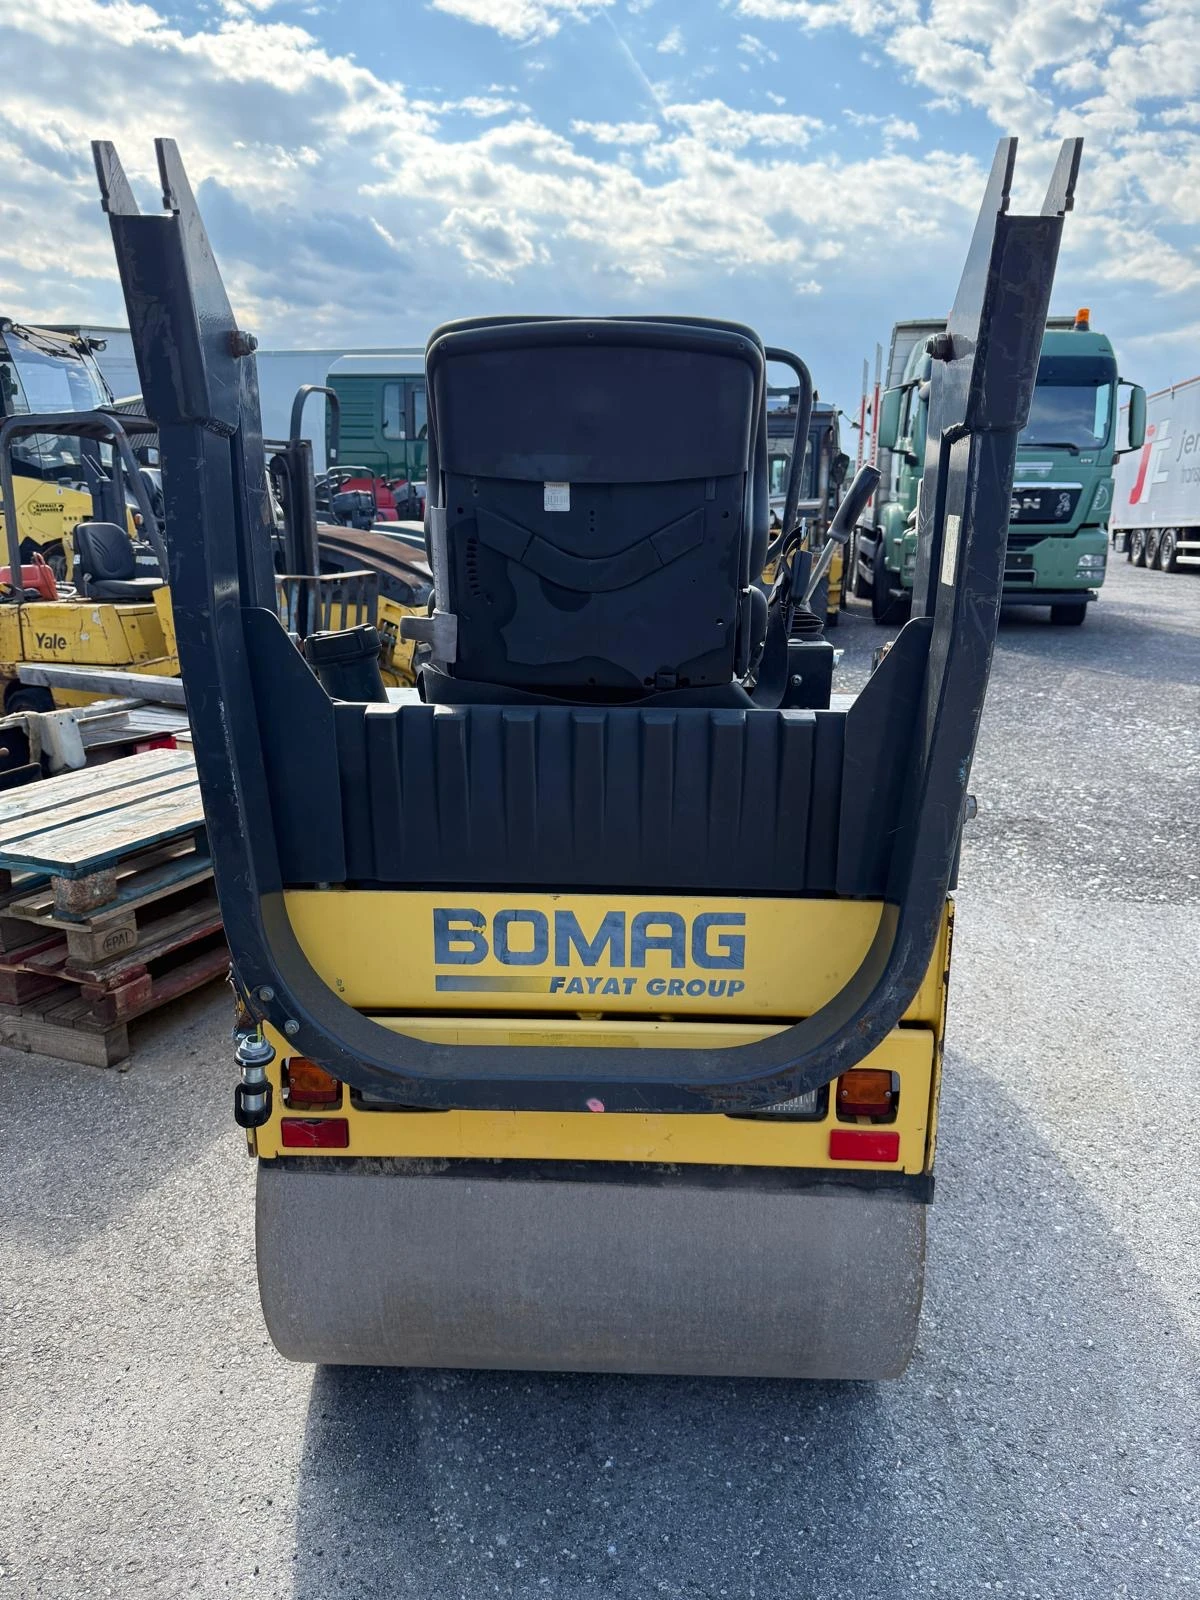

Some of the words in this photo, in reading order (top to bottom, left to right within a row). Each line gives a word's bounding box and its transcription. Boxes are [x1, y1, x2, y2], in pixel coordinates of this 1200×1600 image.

[1010, 497, 1041, 509] AN
[35, 632, 67, 650] Yale
[433, 907, 746, 970] BOMAG
[549, 976, 638, 996] FAYAT
[645, 978, 745, 998] GROUP
